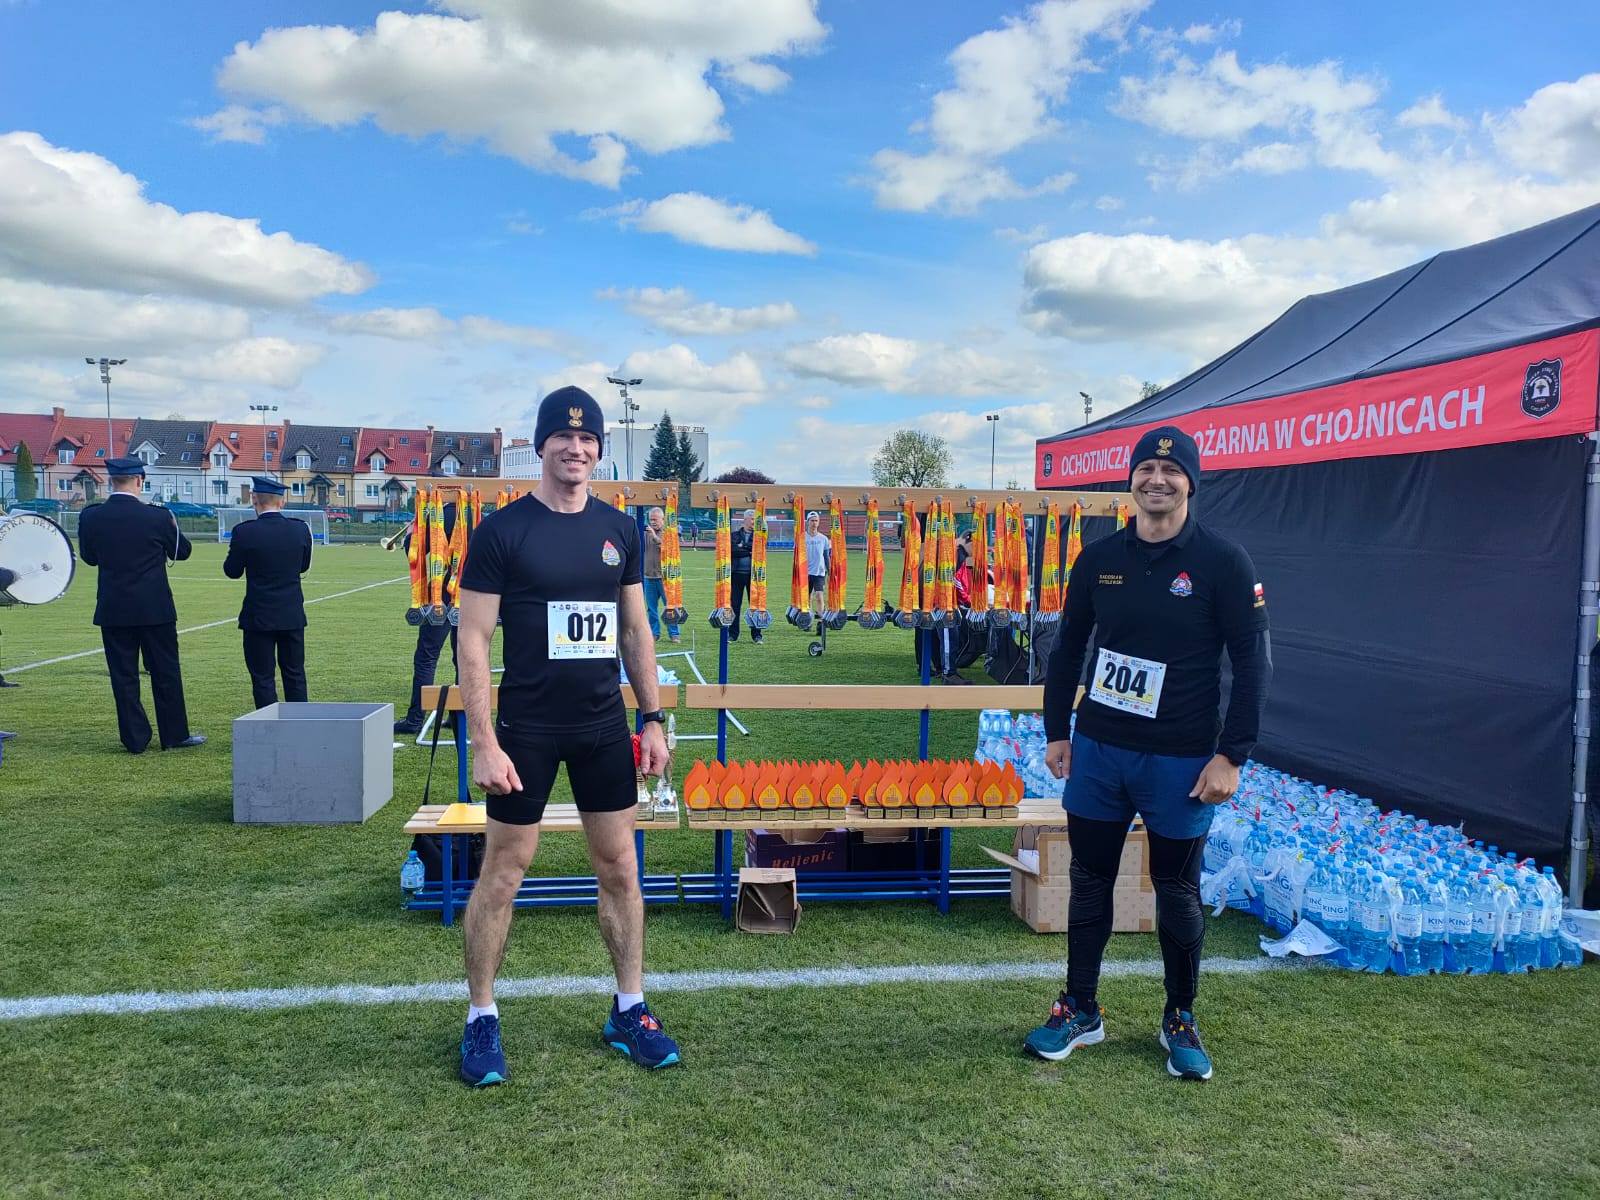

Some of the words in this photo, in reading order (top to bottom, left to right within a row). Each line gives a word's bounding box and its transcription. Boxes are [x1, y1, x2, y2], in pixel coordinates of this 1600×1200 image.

[1060, 446, 1131, 477] OCHOTNICZA
[1193, 419, 1269, 457] OŻARNA
[1273, 418, 1297, 447] W
[1300, 385, 1486, 444] CHOJNICACH
[567, 612, 607, 642] 012
[1102, 661, 1148, 699] 204
[771, 850, 834, 868] Hellenic
